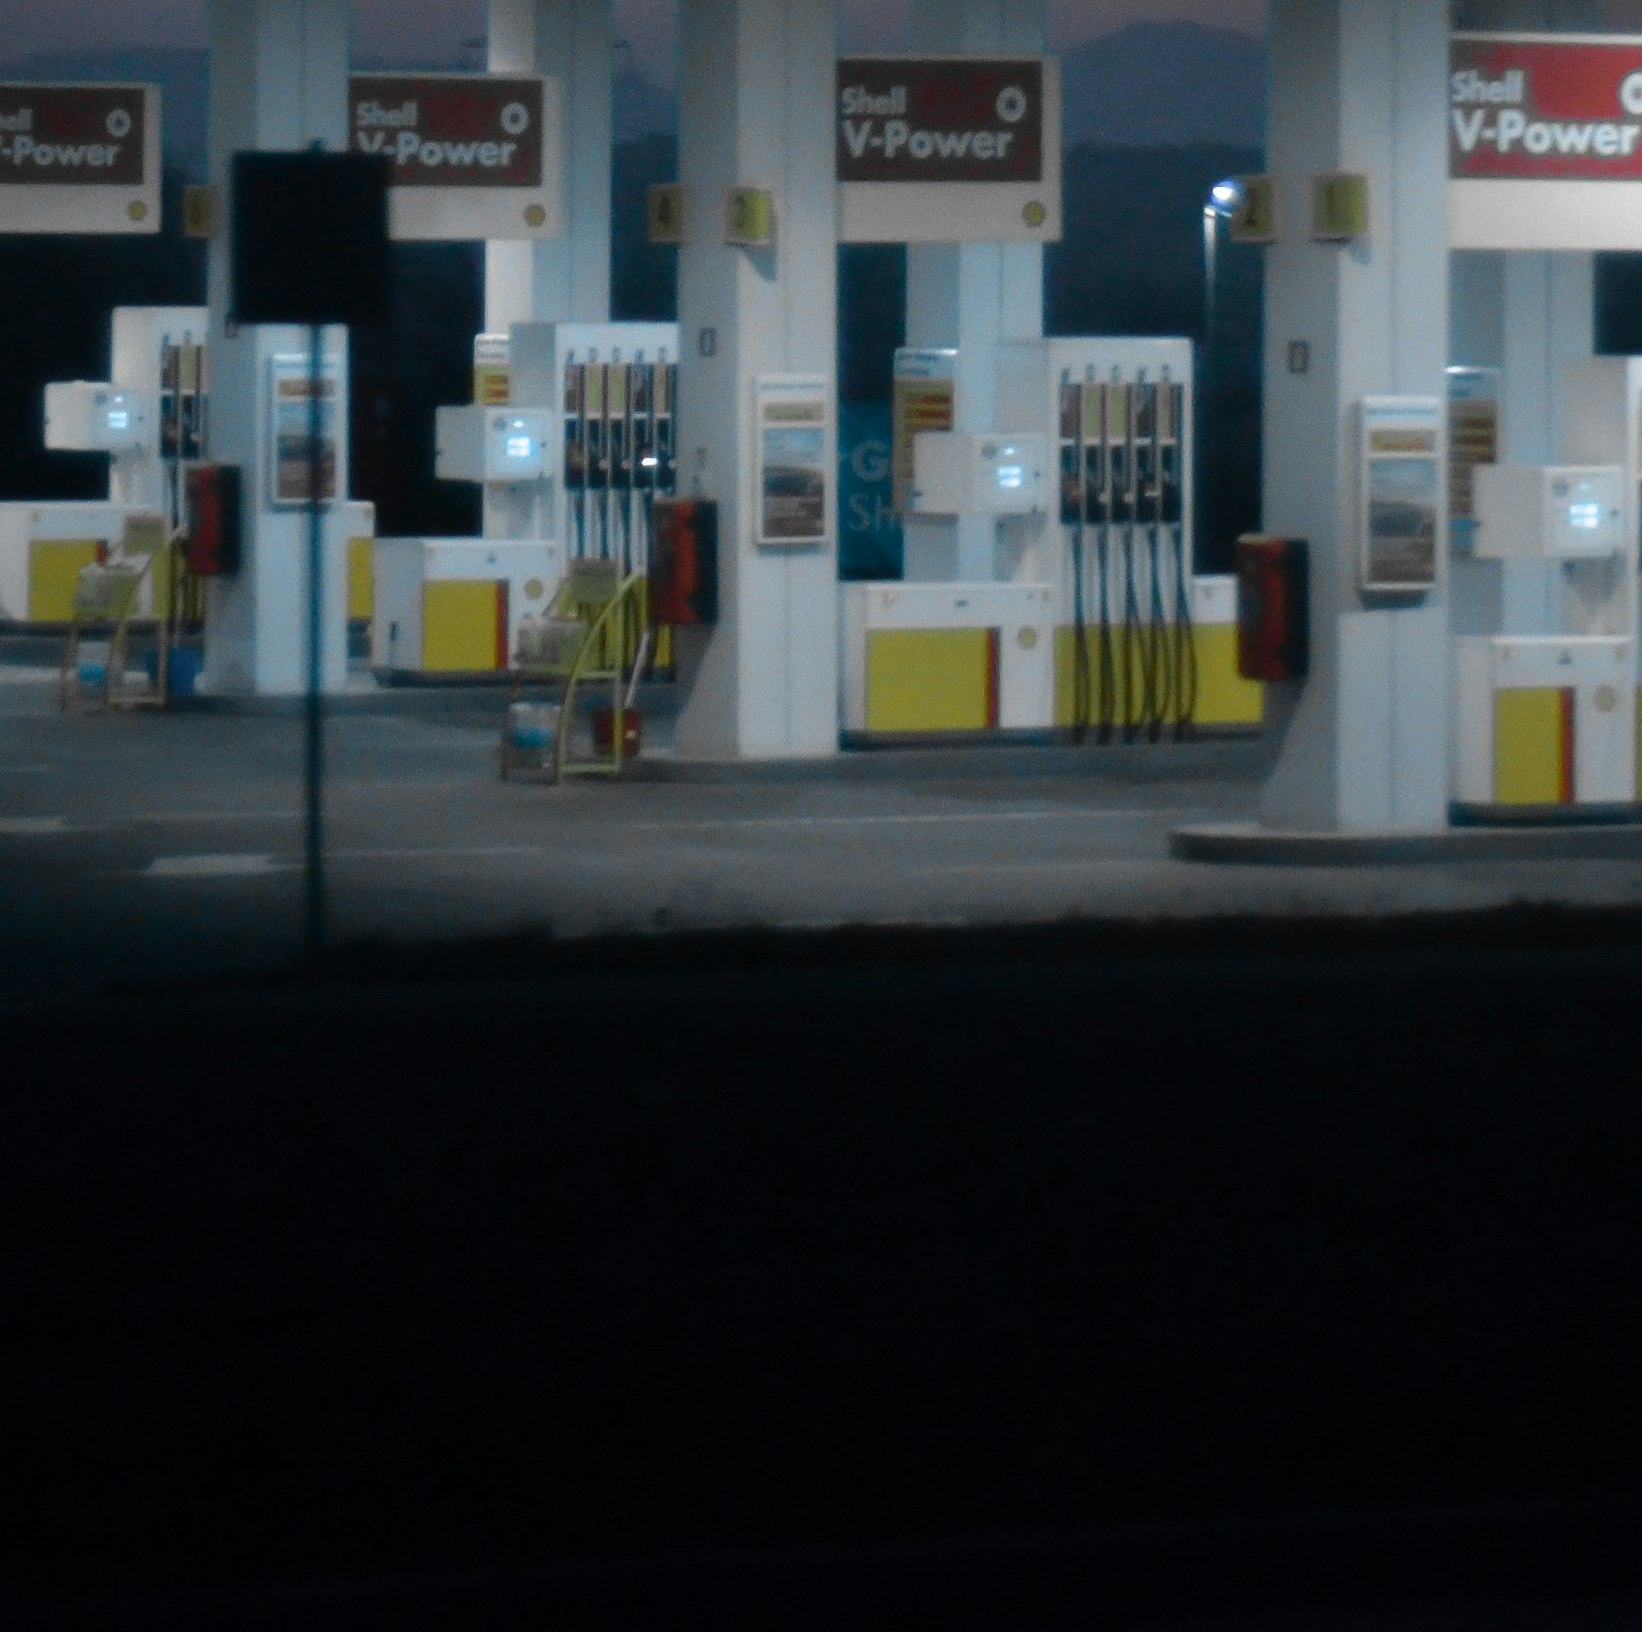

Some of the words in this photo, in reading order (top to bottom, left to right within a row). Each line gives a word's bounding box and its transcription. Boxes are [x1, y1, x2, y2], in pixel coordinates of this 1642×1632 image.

[841, 84, 906, 115] Shell
[1450, 69, 1524, 103] Shell
[356, 100, 419, 127] Shell
[356, 131, 518, 166] V-Power
[842, 119, 1014, 160] V-Power
[1452, 108, 1642, 156] V-Power
